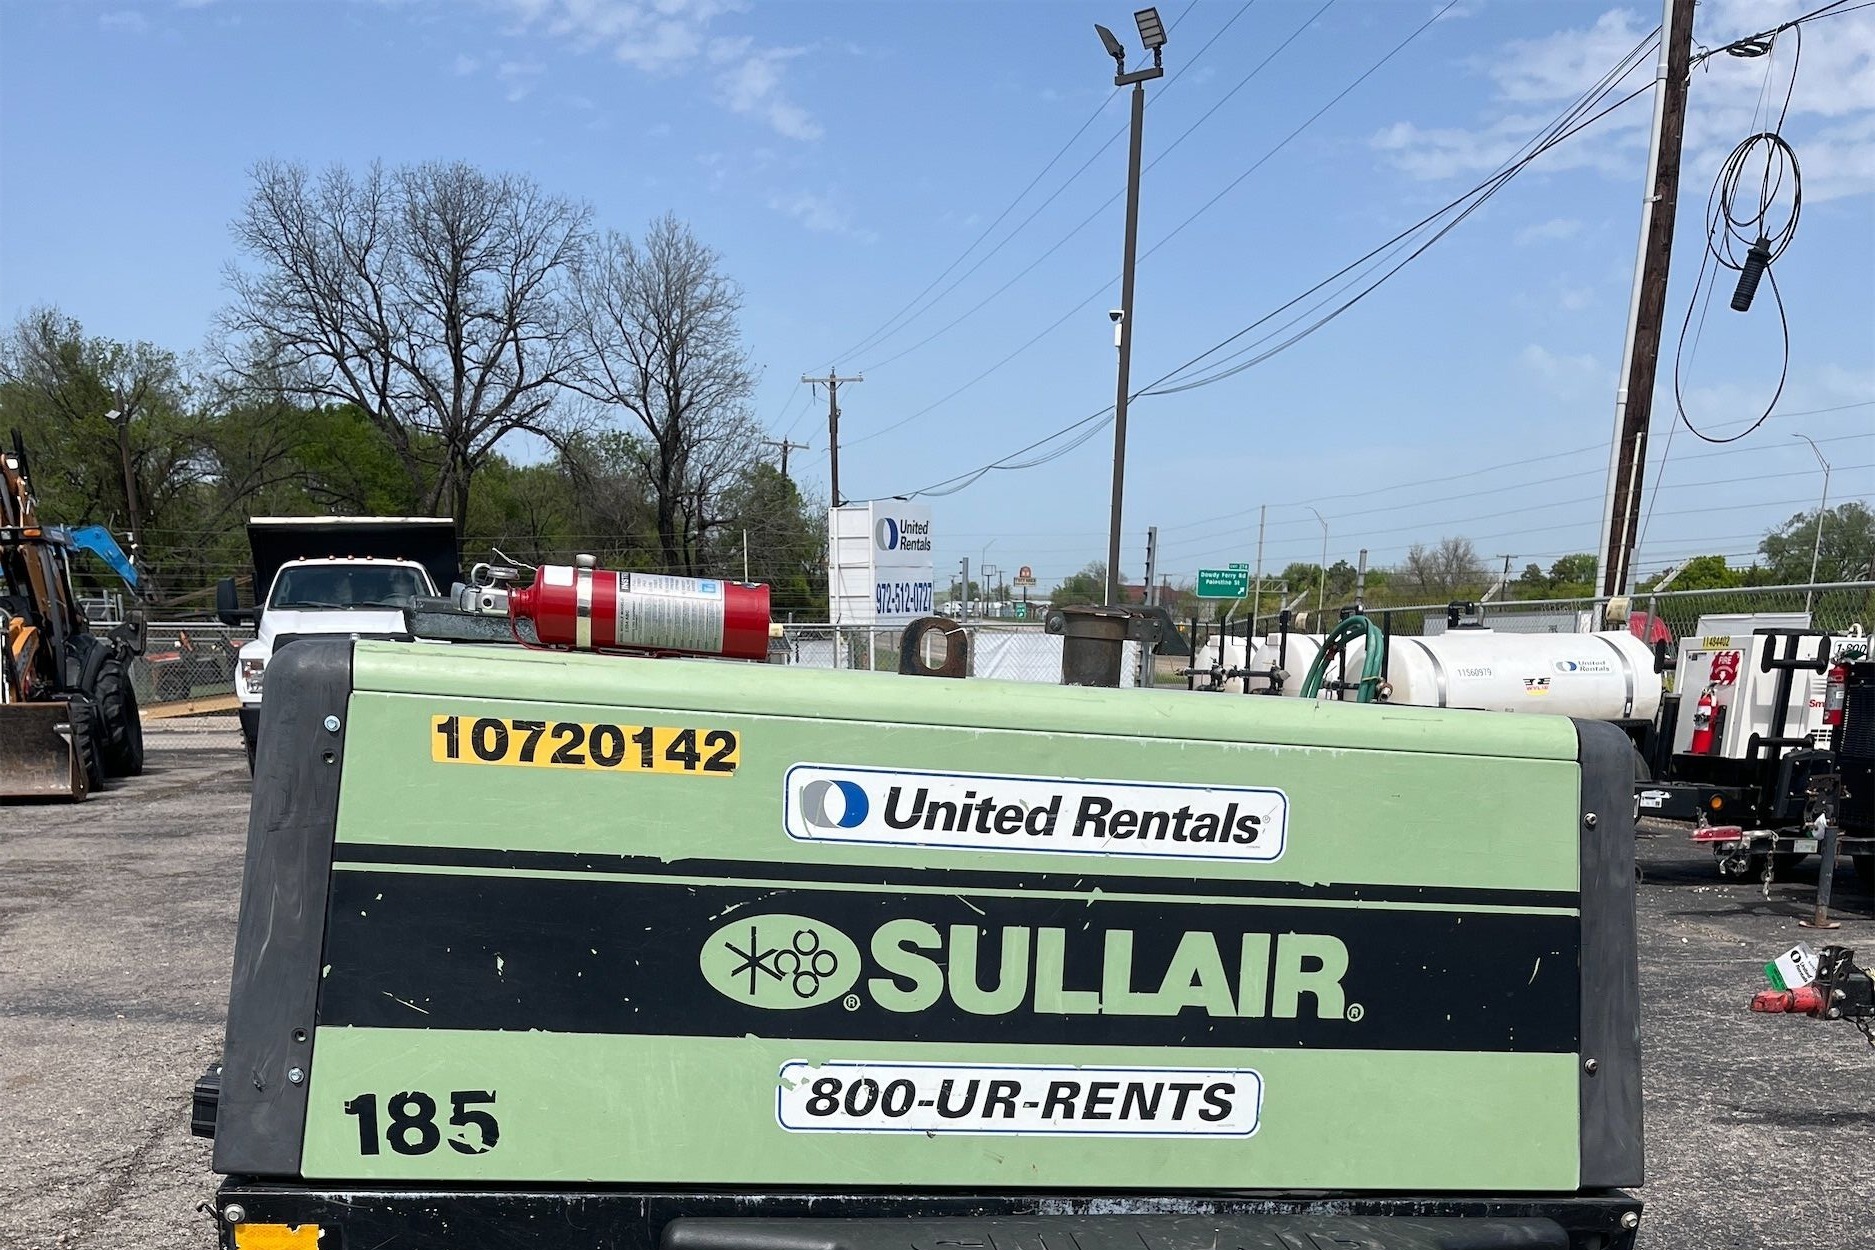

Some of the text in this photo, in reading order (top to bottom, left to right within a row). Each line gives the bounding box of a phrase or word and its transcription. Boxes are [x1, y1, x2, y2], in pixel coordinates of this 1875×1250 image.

[900, 519, 929, 535] United
[900, 536, 931, 551] Rentals
[1222, 572, 1237, 580] Ferry
[876, 582, 932, 614] 972-512-0727
[1457, 668, 1492, 677] 11560979
[1809, 699, 1825, 708] Sm
[438, 716, 738, 773] 10720142
[884, 787, 1261, 844] United Rentals
[867, 918, 1349, 1020] SULLAIR
[805, 1077, 1236, 1122] 800-UR-RENTS
[344, 1090, 500, 1156] 185
